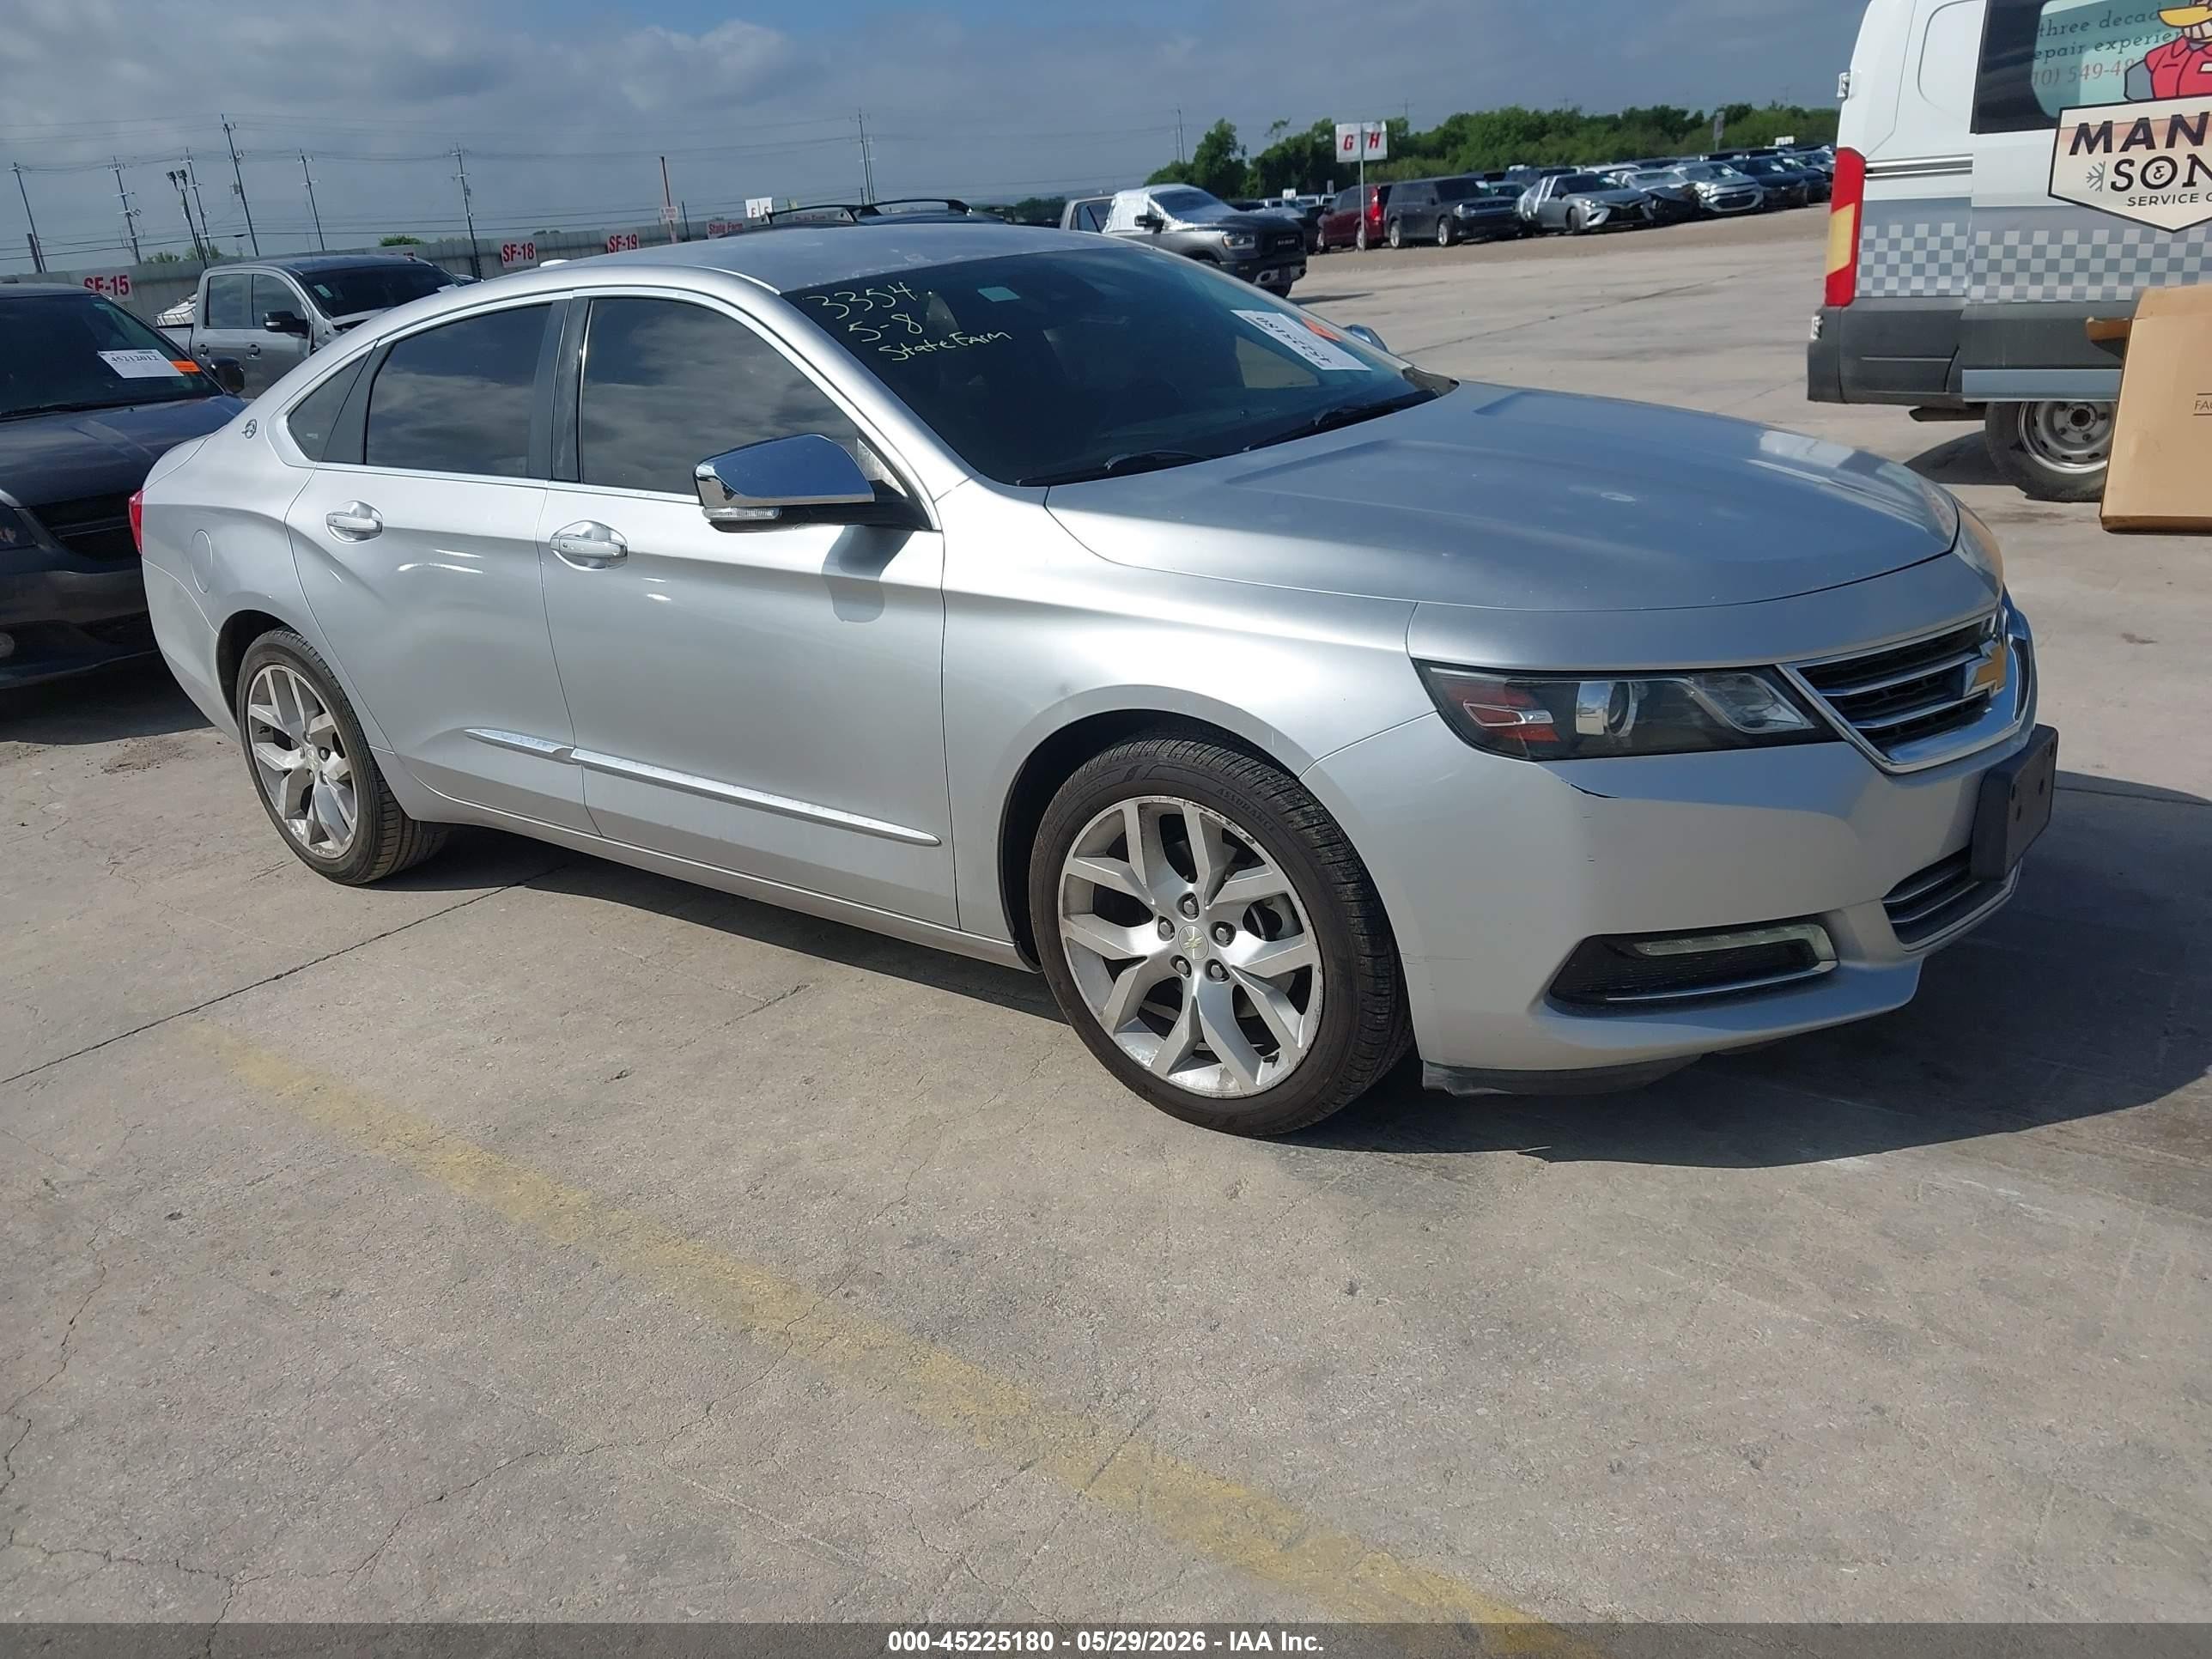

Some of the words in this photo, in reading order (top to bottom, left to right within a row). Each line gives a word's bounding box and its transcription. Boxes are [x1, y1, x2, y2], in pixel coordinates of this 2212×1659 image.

[2039, 19, 2090, 37] three
[1343, 134, 1354, 151] G
[1369, 132, 1381, 149] H
[2127, 192, 2200, 207] SERVICE
[502, 242, 534, 263] SF-18
[609, 234, 637, 253] SF-19
[83, 274, 130, 296] SF-15
[804, 282, 917, 319] 3354
[848, 313, 922, 342] 5-8
